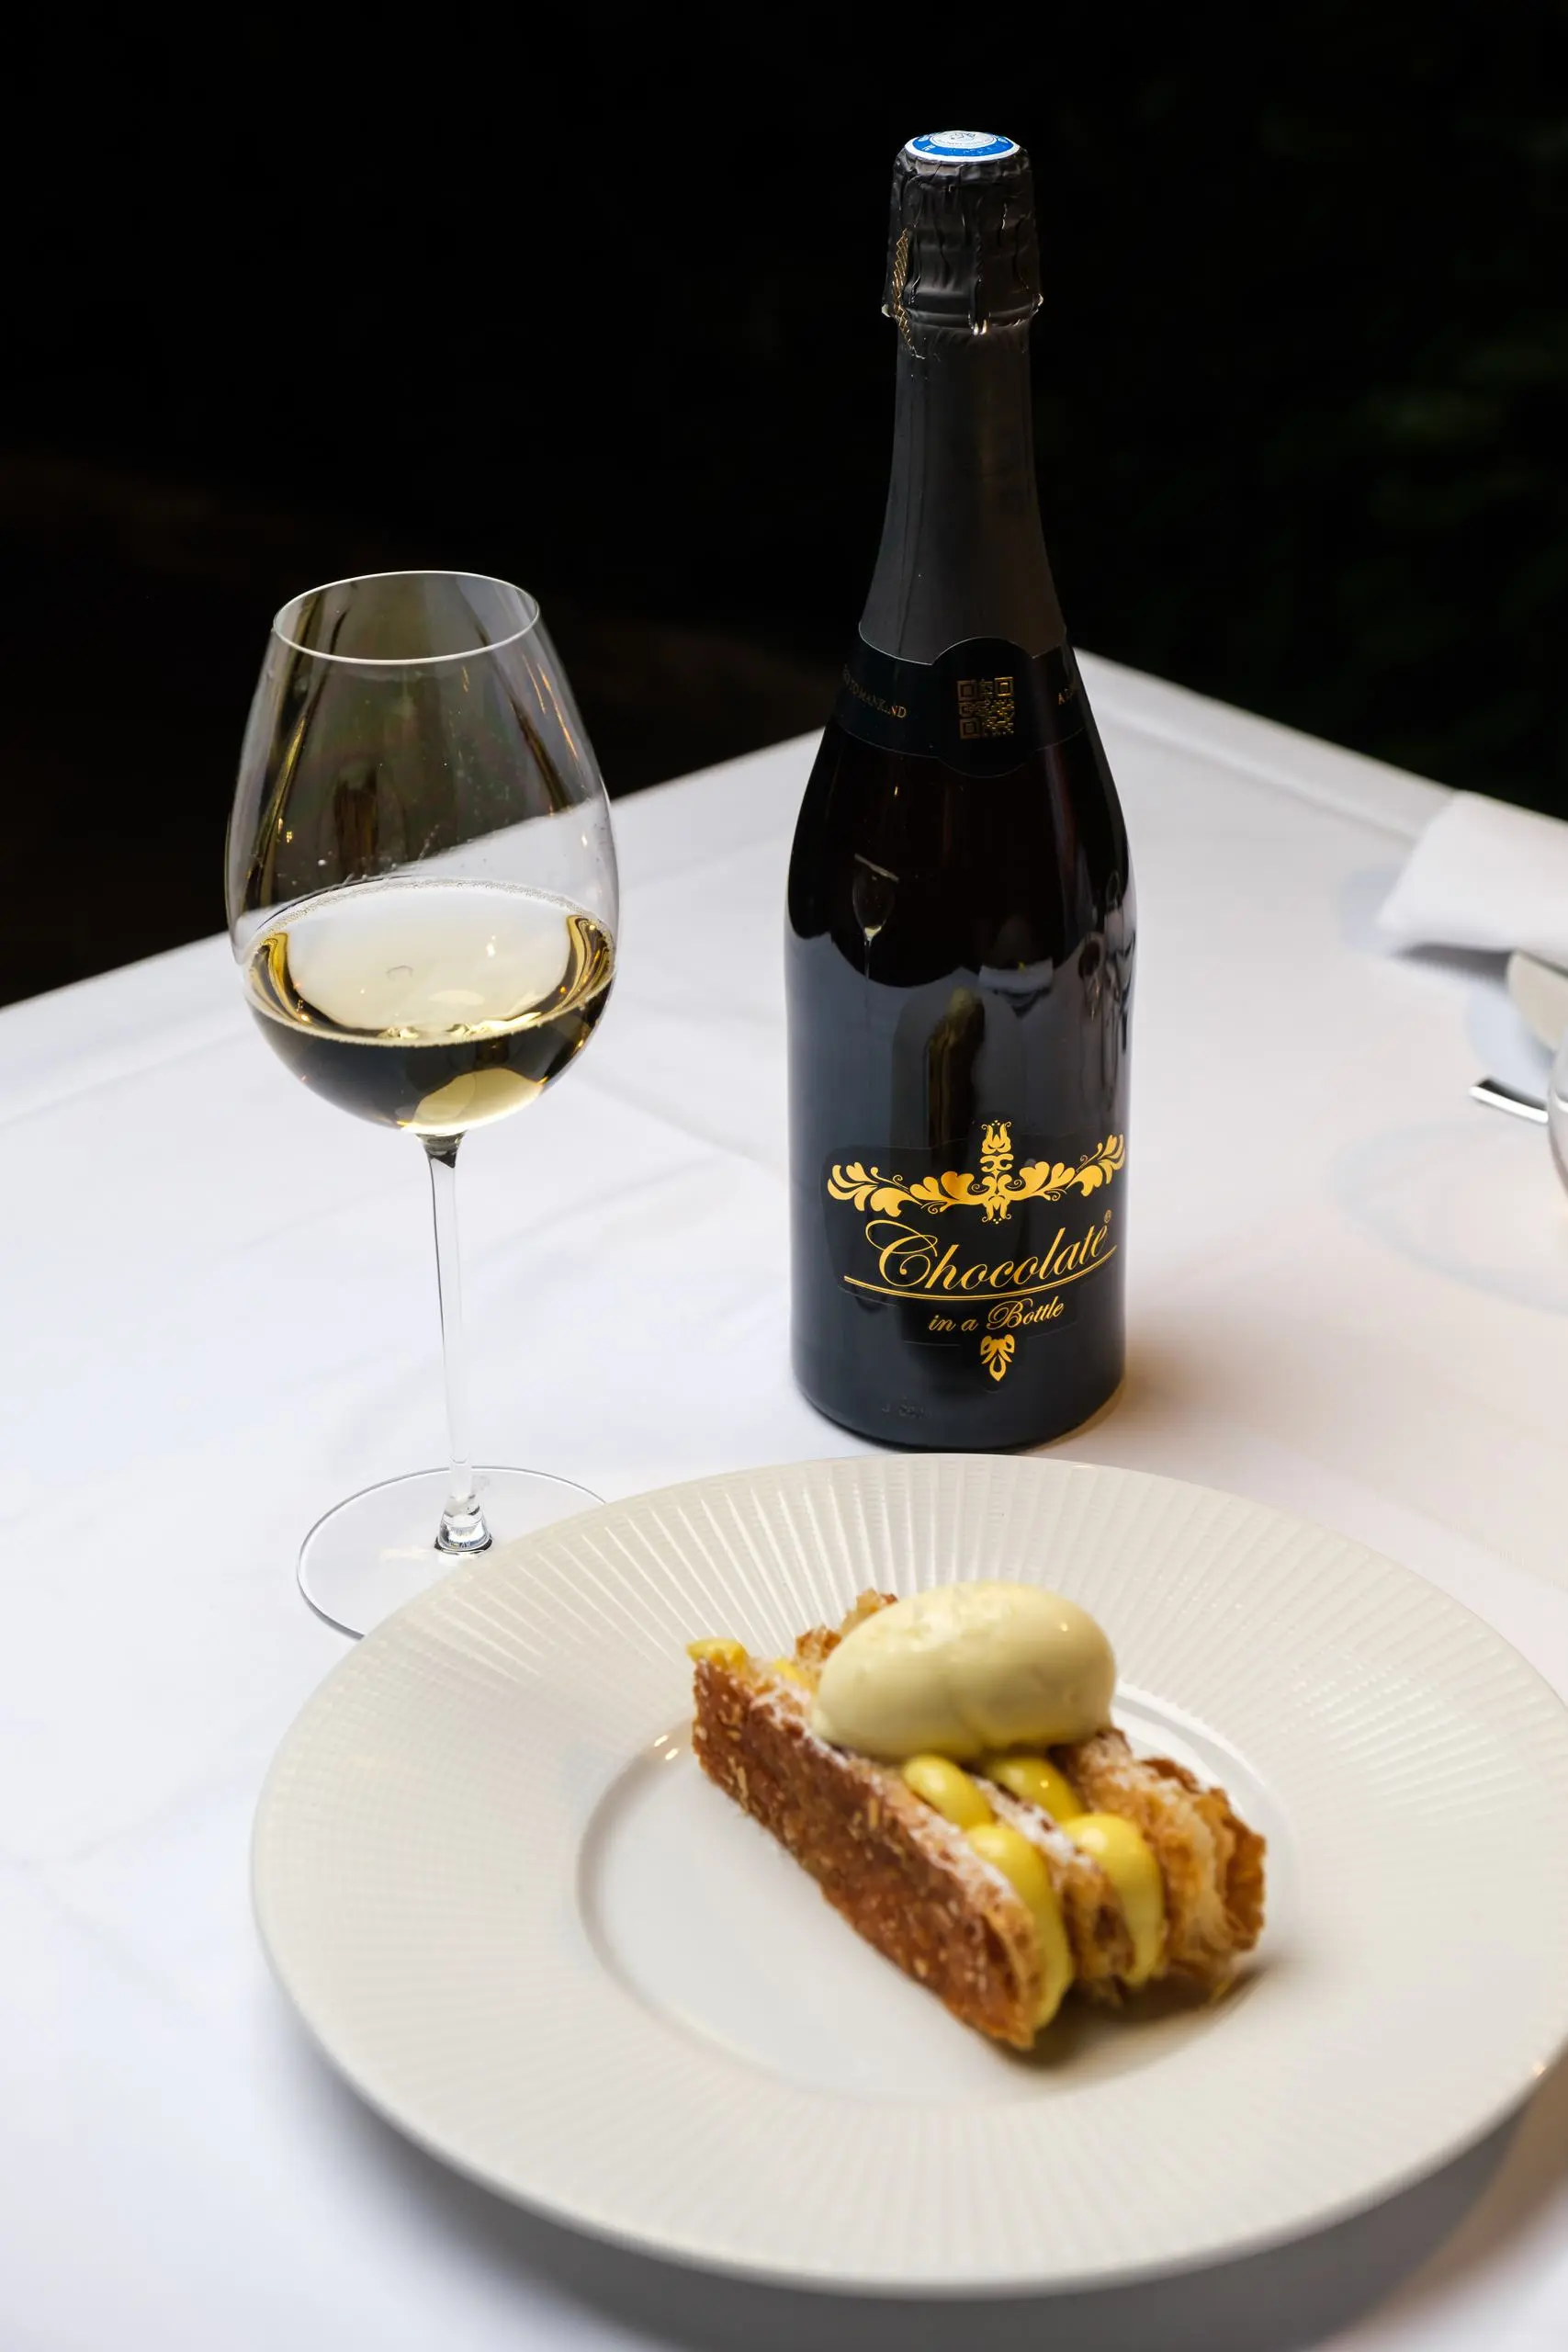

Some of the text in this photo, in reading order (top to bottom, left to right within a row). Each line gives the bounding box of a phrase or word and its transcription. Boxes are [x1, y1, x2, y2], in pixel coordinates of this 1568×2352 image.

[928, 1295, 1065, 1332] in a Bottle
